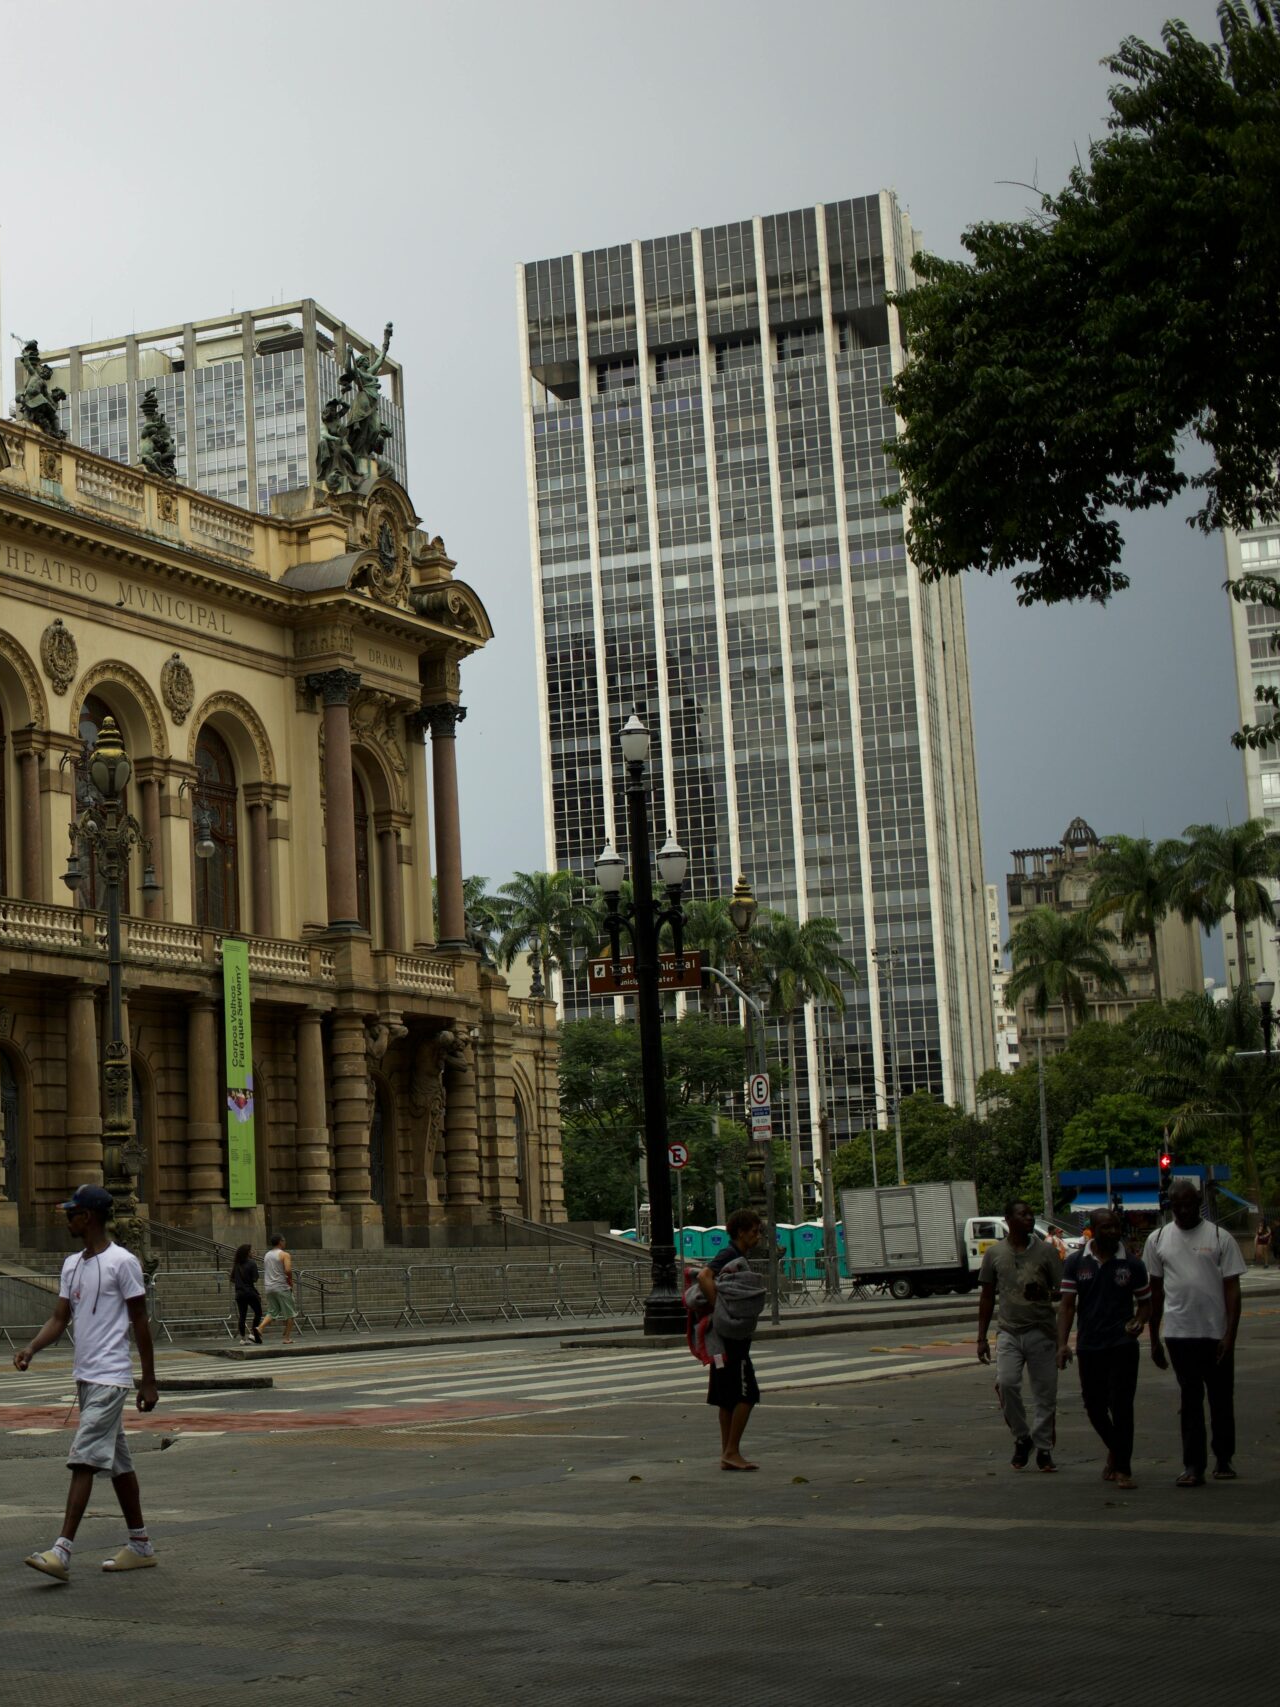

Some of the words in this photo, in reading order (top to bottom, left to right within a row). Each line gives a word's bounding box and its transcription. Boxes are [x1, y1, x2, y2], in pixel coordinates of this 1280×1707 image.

[117, 580, 234, 636] MVNICIPAL
[368, 647, 404, 672] DRAMA
[231, 1025, 239, 1068] Corpos
[756, 1081, 764, 1098] E
